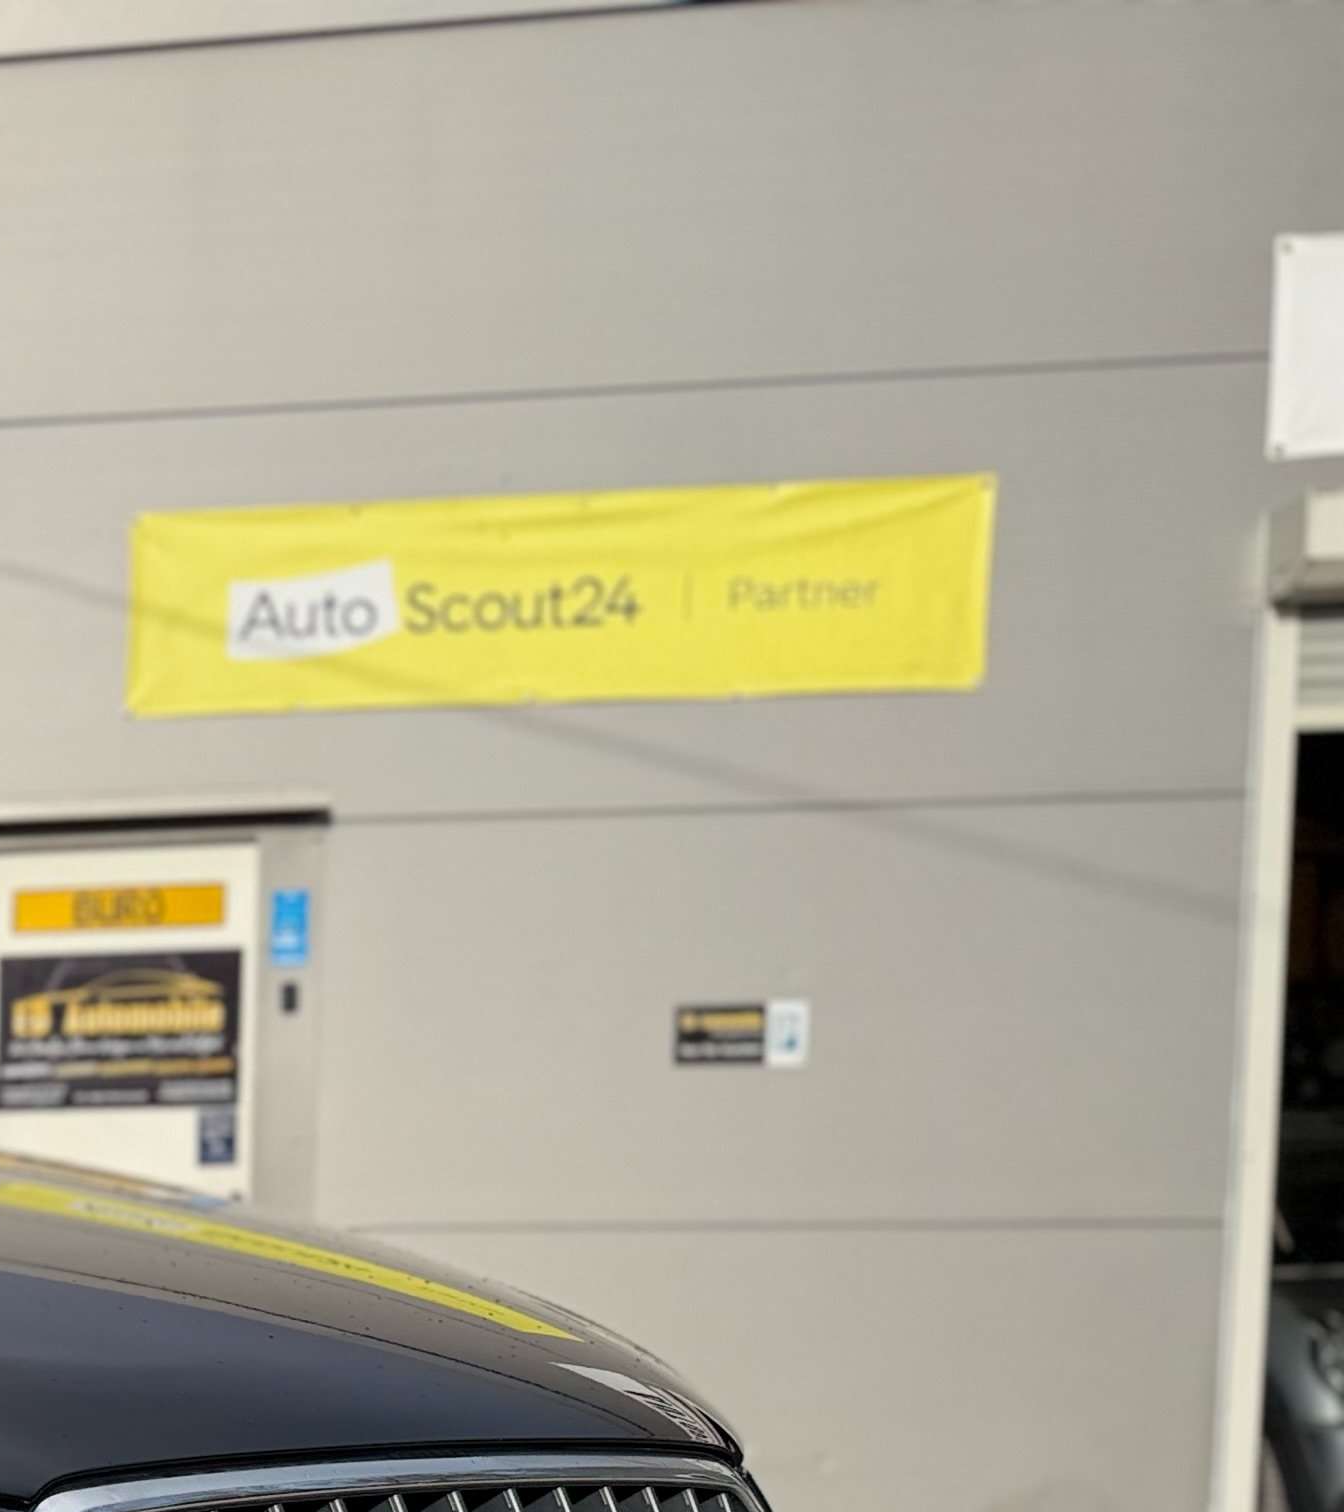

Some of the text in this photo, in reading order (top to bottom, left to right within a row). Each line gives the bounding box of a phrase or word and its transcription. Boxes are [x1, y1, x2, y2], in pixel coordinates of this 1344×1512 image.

[240, 575, 879, 641] Auto Scout24 Partner
